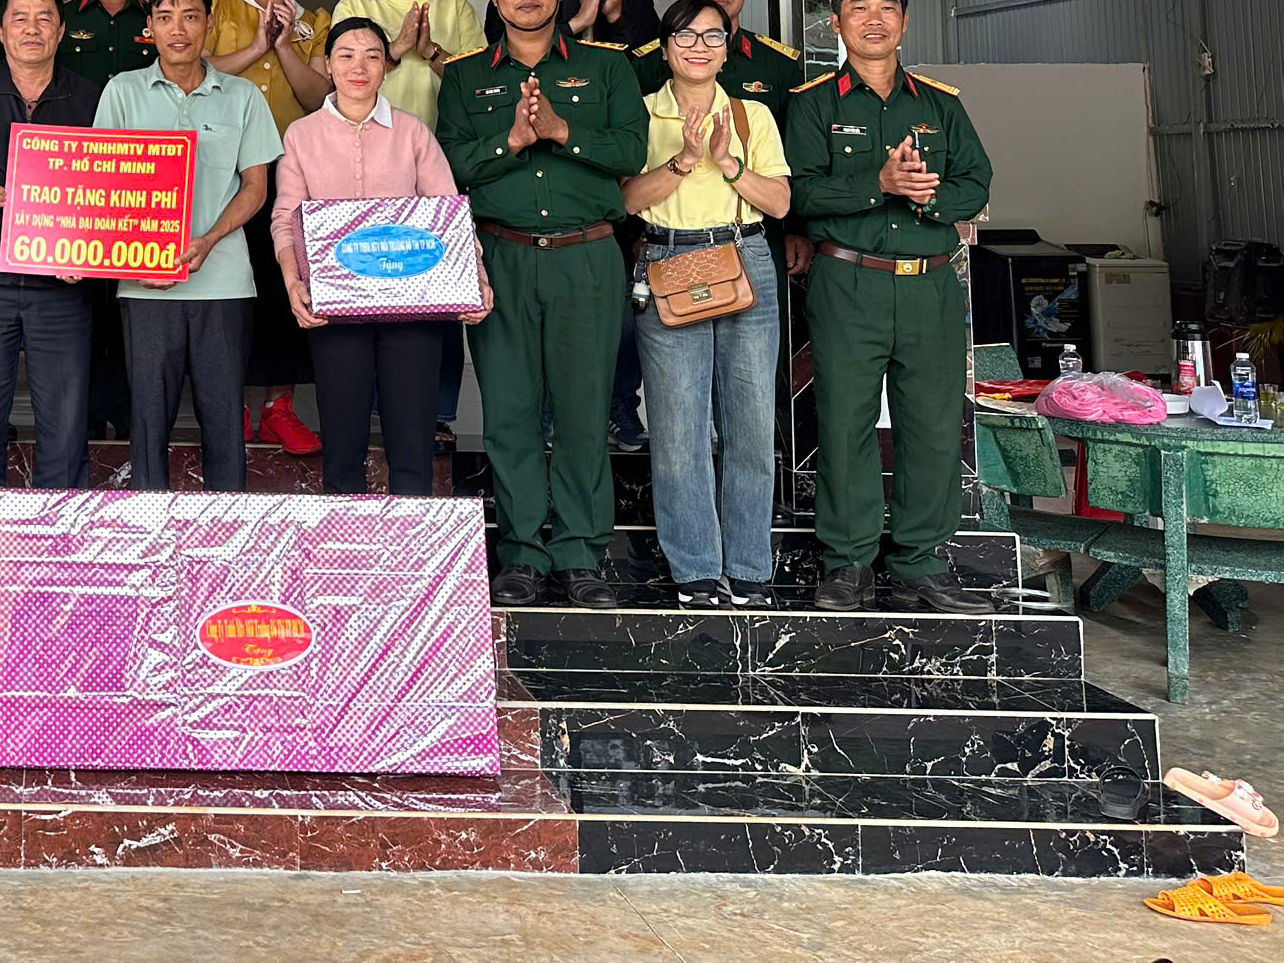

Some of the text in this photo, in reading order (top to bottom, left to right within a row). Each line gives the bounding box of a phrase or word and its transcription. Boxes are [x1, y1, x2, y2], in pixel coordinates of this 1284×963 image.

[22, 137, 184, 156] CÔNG TY TNHHMTV MTĐT
[48, 158, 67, 170] TP.
[93, 159, 116, 173] CHÍ
[120, 161, 155, 174] MINH
[21, 185, 179, 210] TRAO TẶNG KINH PHÍ
[79, 218, 92, 232] ĐẠI
[95, 217, 116, 230] ĐOÀN
[140, 217, 158, 232] NĂM
[160, 220, 180, 232] 2025
[14, 235, 176, 269] 60.000.000đ
